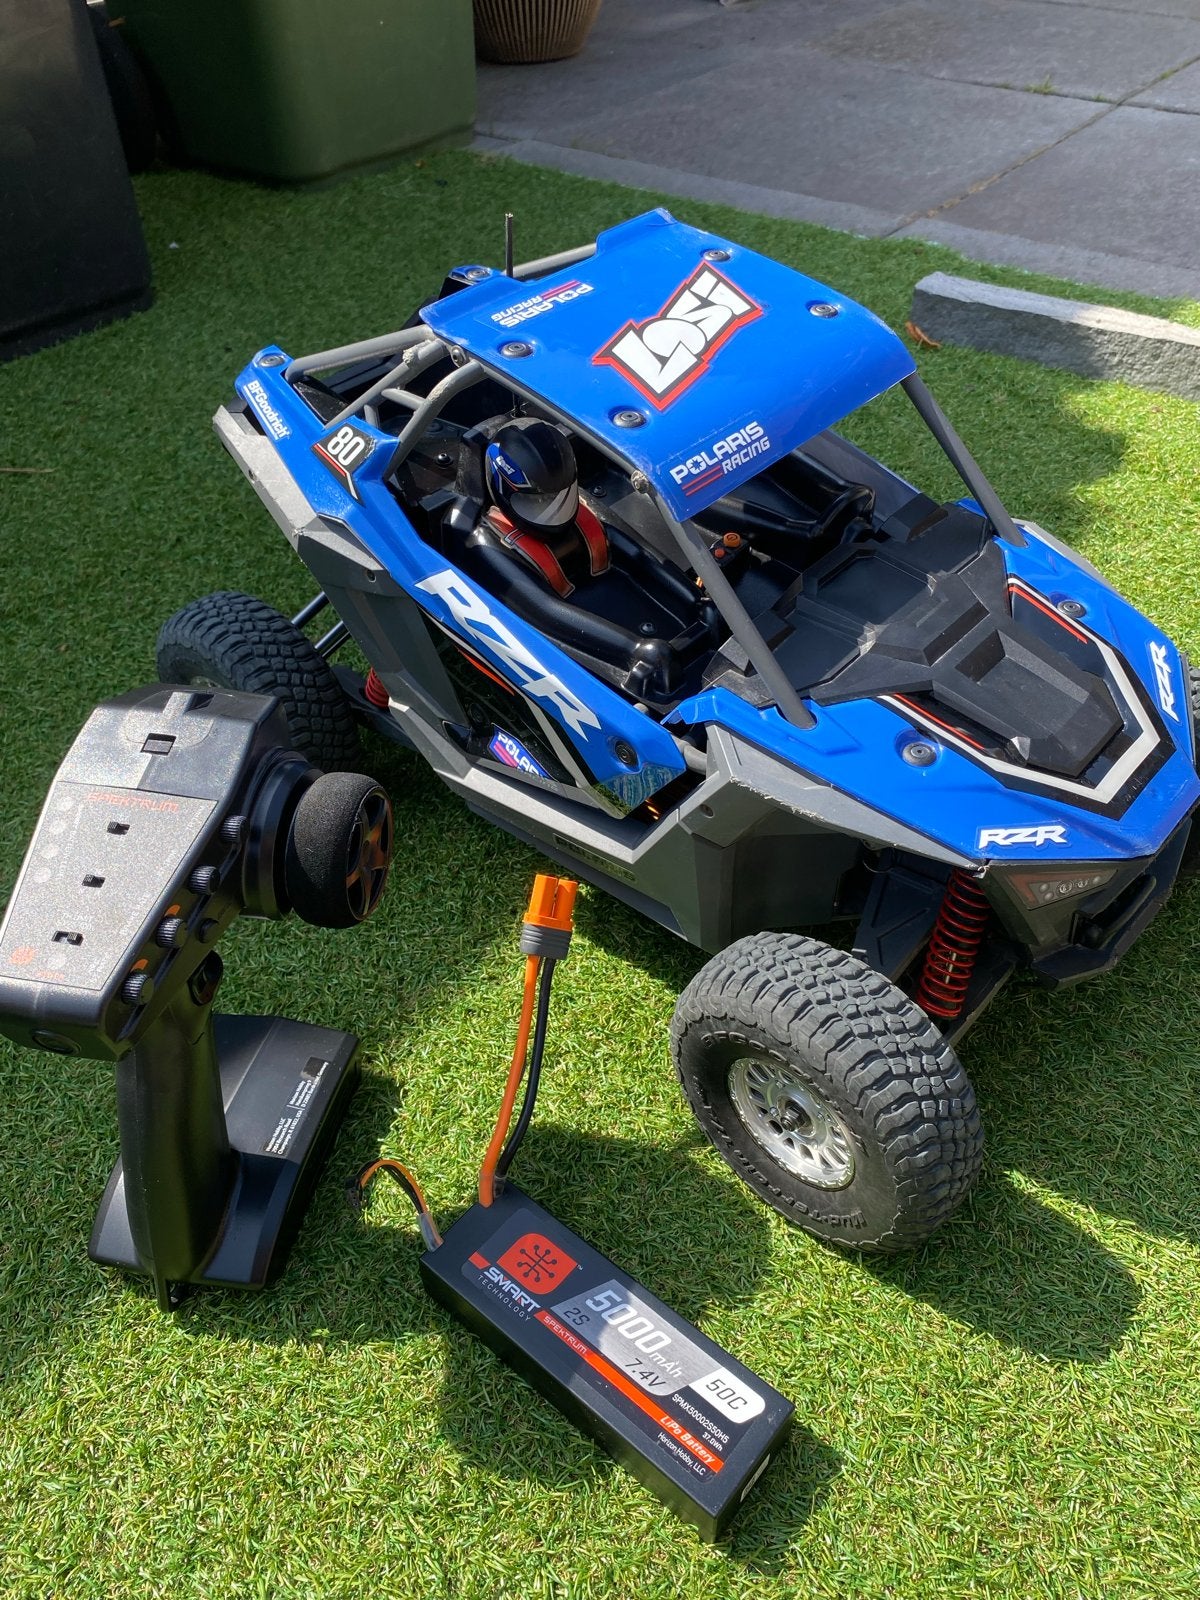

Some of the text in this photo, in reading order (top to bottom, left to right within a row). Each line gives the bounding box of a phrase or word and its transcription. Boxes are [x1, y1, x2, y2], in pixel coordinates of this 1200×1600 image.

[491, 295, 543, 322] RACING
[500, 283, 594, 328] POLARIS
[248, 380, 290, 438] BFGoodrich
[327, 426, 365, 466] 80
[669, 421, 764, 485] POLARIS
[721, 436, 771, 474] RACING
[414, 569, 602, 743] RZR
[1149, 641, 1180, 722] RZR
[979, 825, 1067, 849] RZR
[477, 1275, 531, 1322] TECHNOLOGY
[483, 1266, 541, 1312] SMART
[543, 1315, 587, 1354] SPEKTRUM
[563, 1307, 666, 1388] 2S 7.4V
[706, 1378, 748, 1411] 50C
[660, 1415, 716, 1463] LiPo Battery
[672, 1393, 730, 1444] SPMX50002S50H5
[657, 1431, 706, 1476] Horizon Hobby, LLC
[702, 1431, 723, 1452] 37.0Wh
